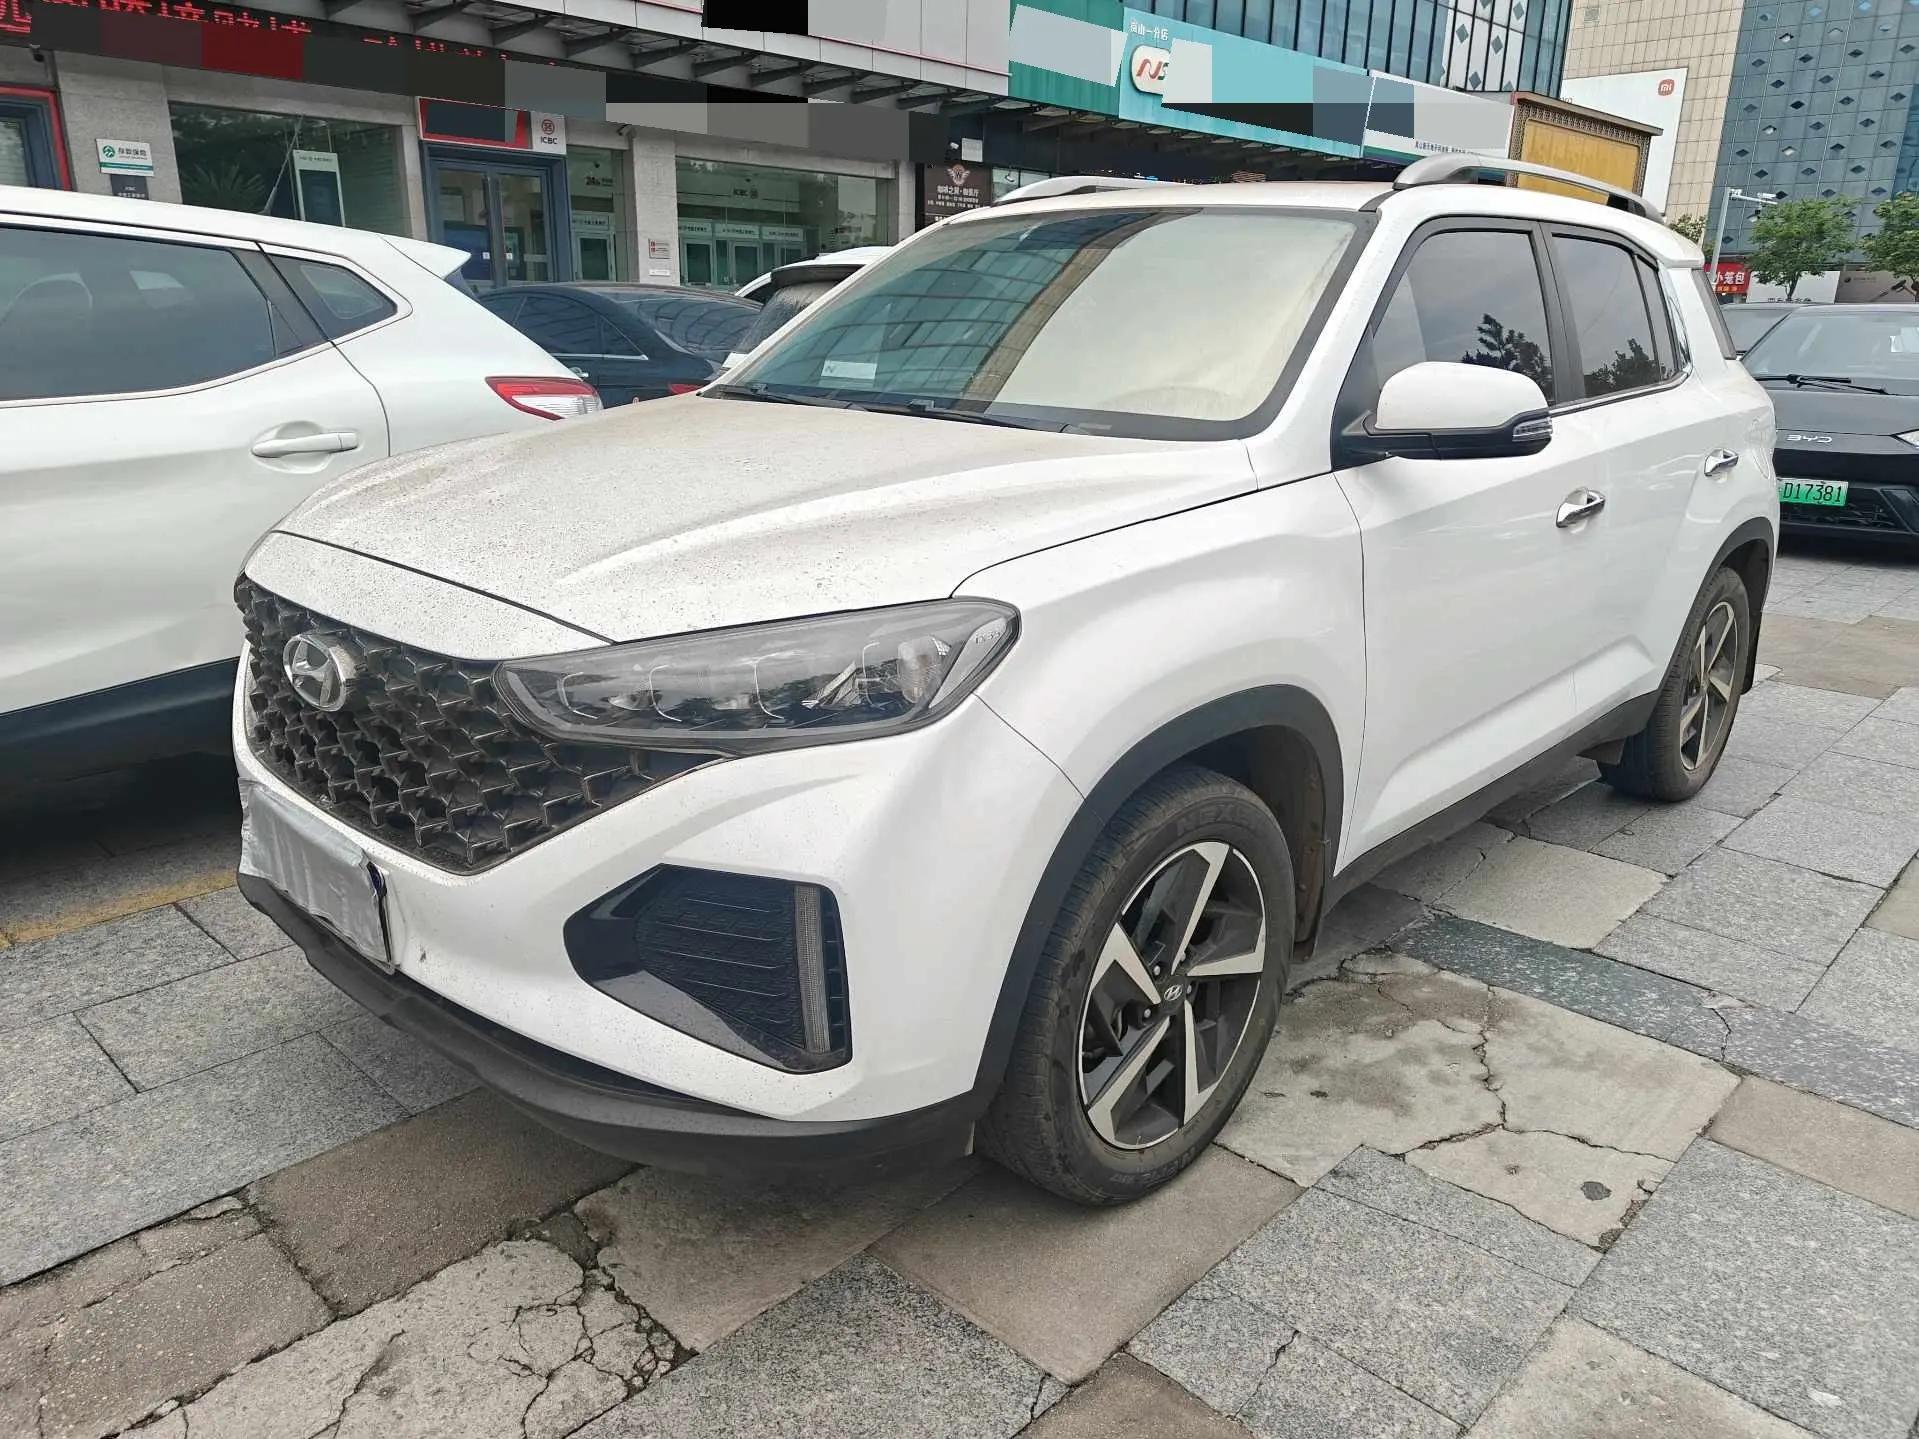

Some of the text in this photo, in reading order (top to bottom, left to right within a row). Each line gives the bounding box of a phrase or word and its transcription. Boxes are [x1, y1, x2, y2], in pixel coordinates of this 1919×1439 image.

[541, 136, 557, 144] ICBC
[1787, 434, 1832, 443] BYD
[1783, 482, 1842, 503] D17381
